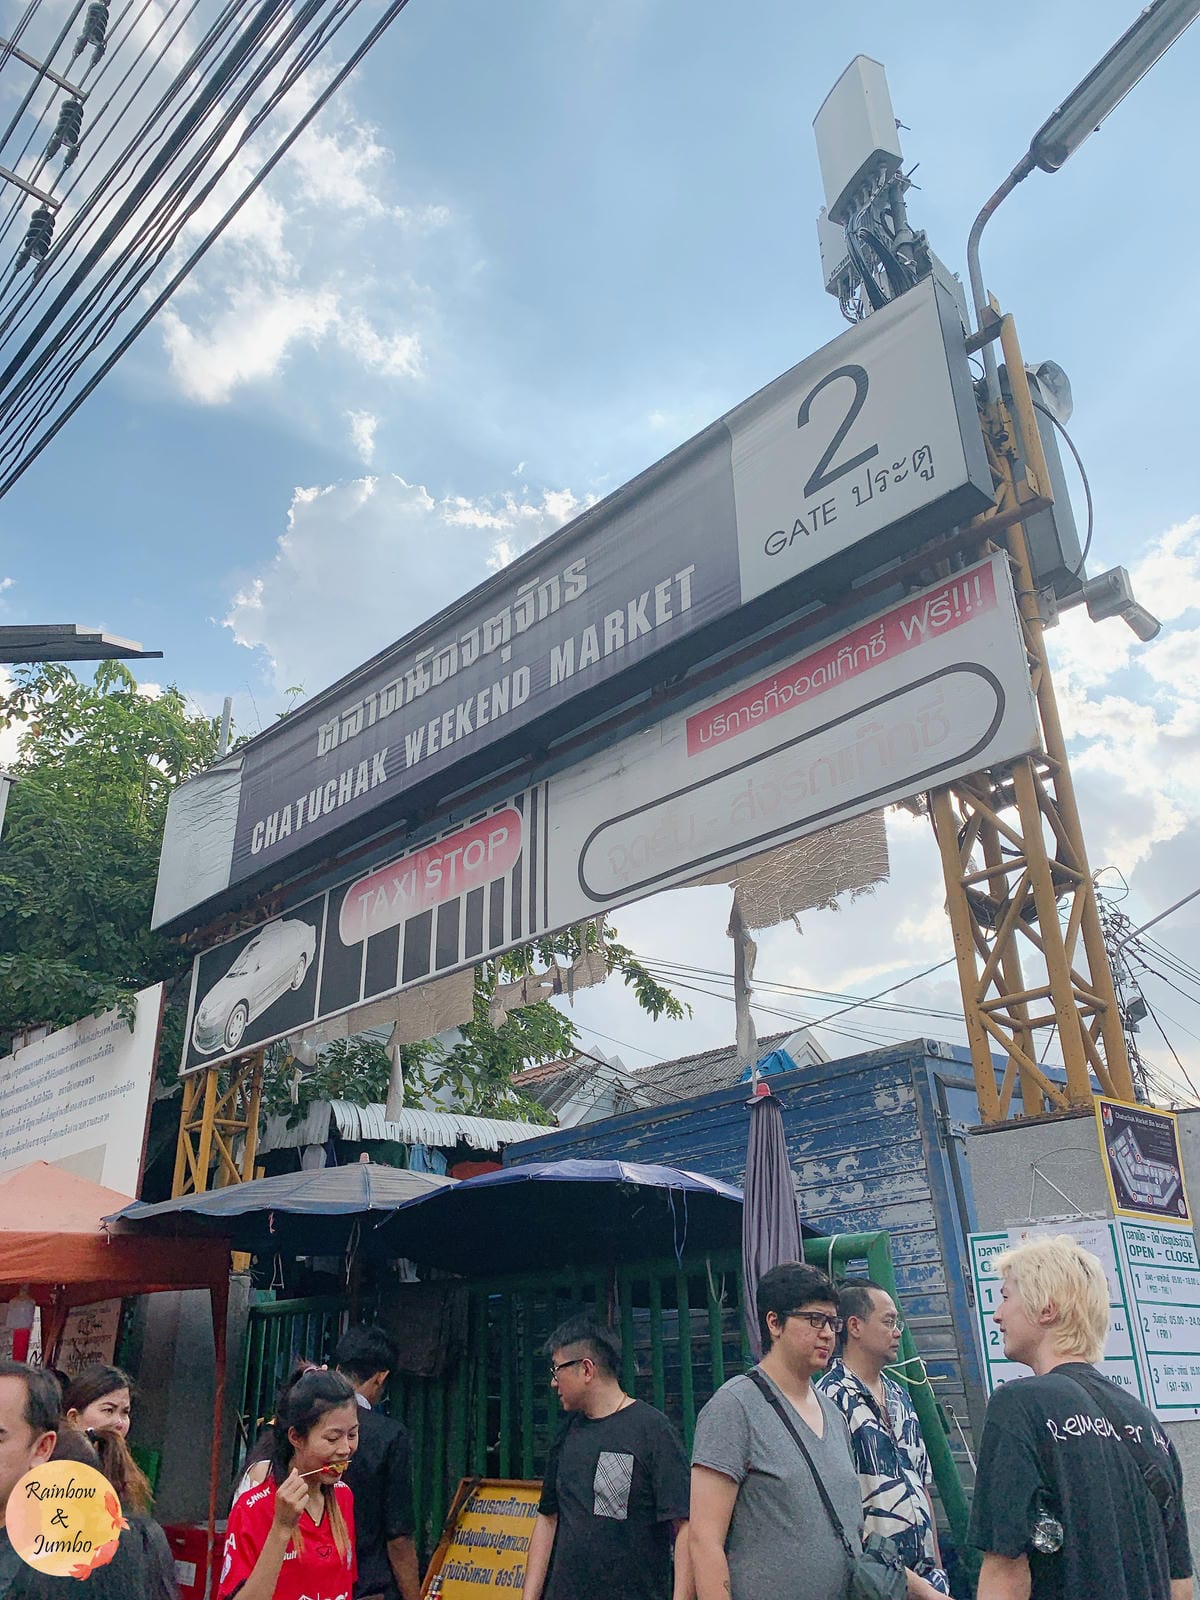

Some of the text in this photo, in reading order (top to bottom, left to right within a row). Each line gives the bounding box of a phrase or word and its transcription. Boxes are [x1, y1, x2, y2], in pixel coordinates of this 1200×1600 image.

[797, 364, 879, 499] 2
[764, 445, 934, 556] GATE ประตู
[899, 575, 984, 642] ฟรี!!!
[316, 556, 589, 757] ตลาดนัดจตุจักร
[251, 563, 695, 855] CHATUCHAK WEEKEND MARKET
[358, 827, 508, 921] TAXI STOP
[1129, 1244, 1155, 1259] OPEN
[1165, 1249, 1195, 1264] CLOSE
[1135, 1273, 1141, 1288] 1
[985, 1288, 993, 1303] 1
[989, 1331, 1000, 1346] 2
[1143, 1317, 1150, 1332] 2
[1153, 1368, 1160, 1384] 3
[1046, 1414, 1143, 1443] Rememer
